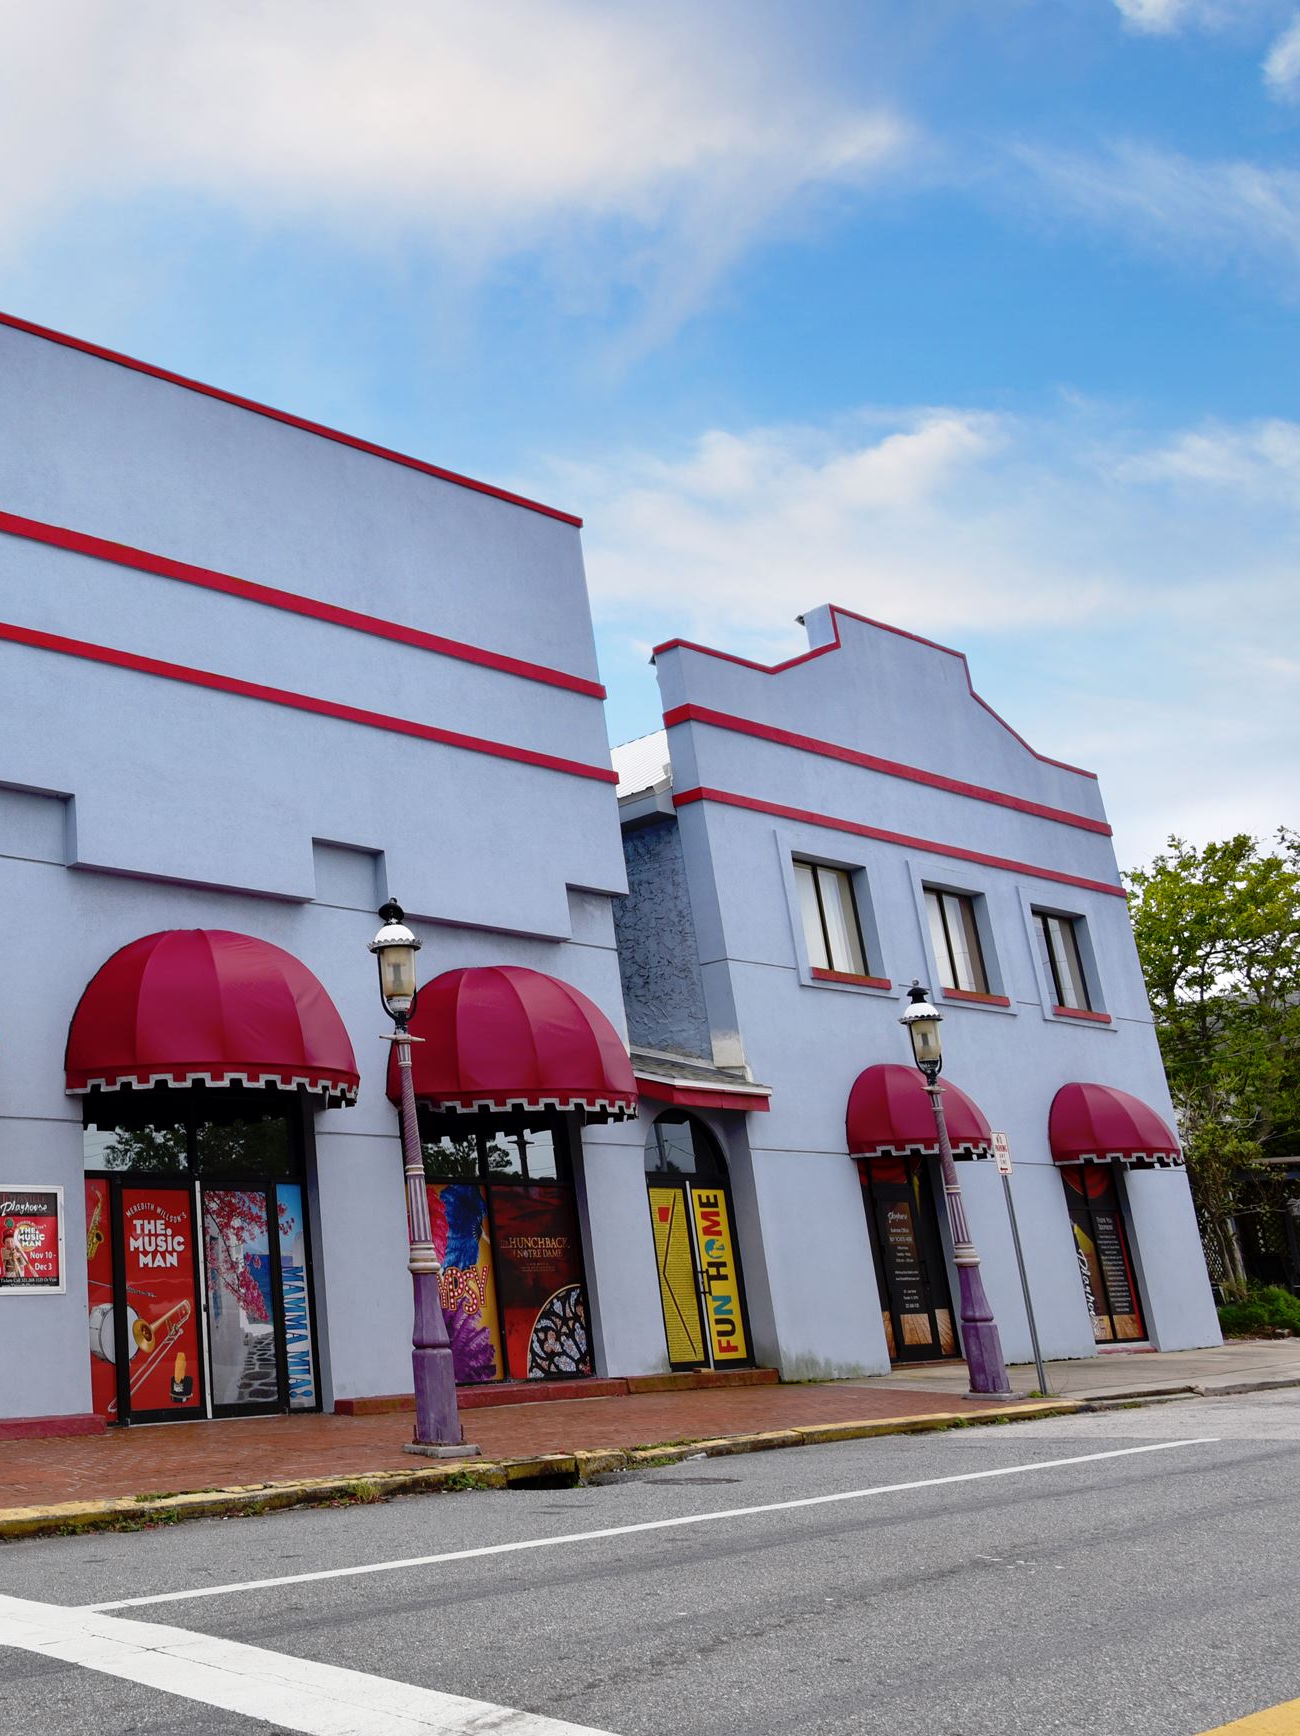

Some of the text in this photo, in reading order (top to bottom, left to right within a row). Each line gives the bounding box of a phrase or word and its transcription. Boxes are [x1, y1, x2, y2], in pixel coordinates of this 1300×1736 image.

[0, 1201, 48, 1216] Playhouse
[125, 1203, 187, 1223] MEREDITH WILLSON'S
[133, 1219, 166, 1235] THE
[139, 1252, 178, 1268] MAN
[698, 1194, 739, 1353] FUN HOME
[437, 1265, 488, 1314] YPSY
[282, 1265, 313, 1398] MAMMA MIA!
